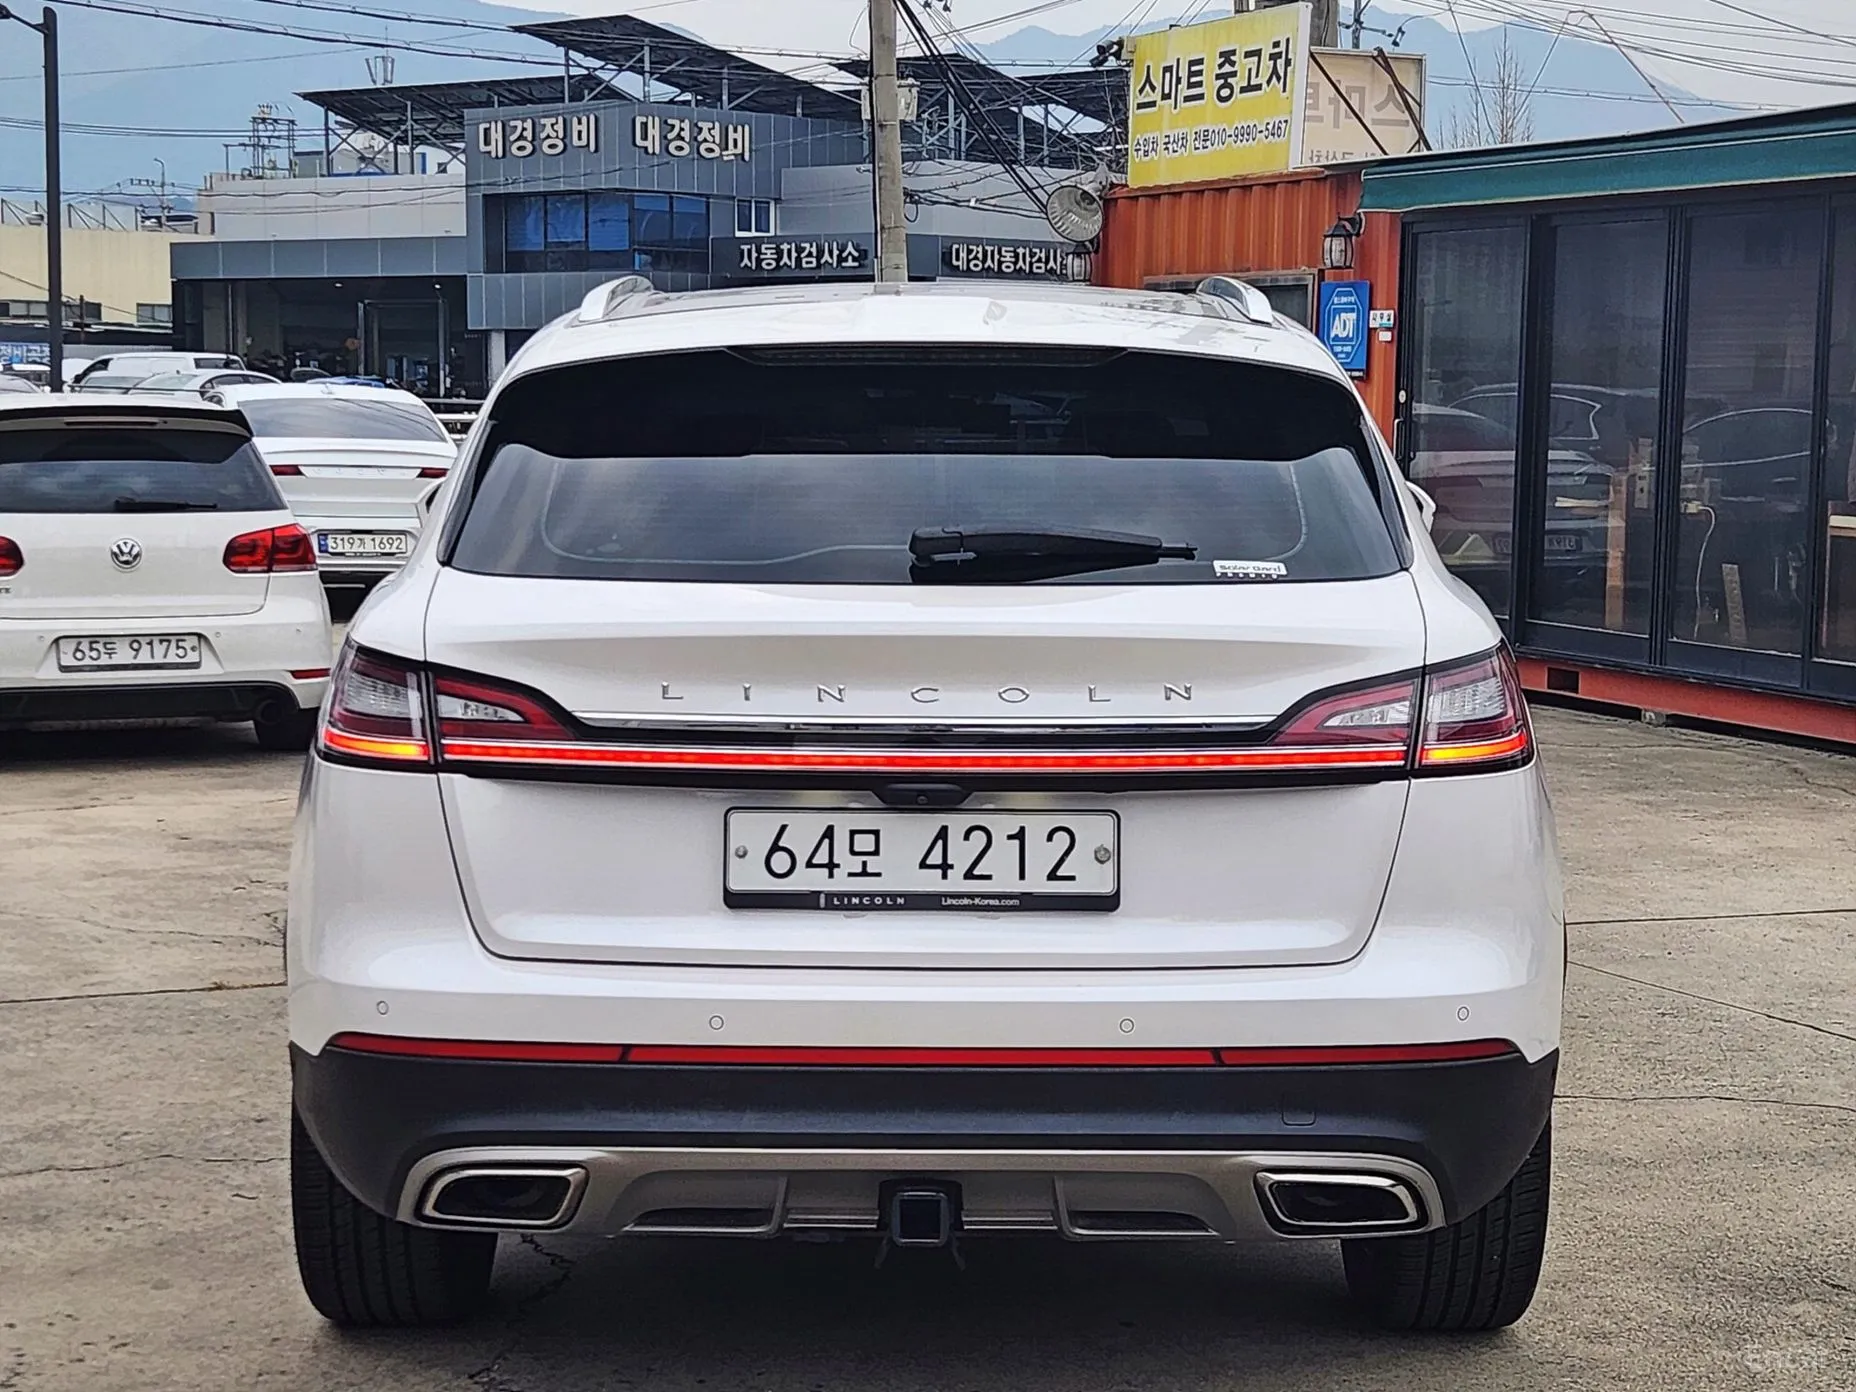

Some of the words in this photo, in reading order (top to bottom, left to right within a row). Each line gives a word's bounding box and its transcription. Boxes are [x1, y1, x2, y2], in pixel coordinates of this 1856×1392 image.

[1136, 57, 1205, 110] 스마트
[1215, 37, 1292, 103] 중고차
[478, 113, 596, 158] 대경정비
[635, 115, 750, 162] 대경정비
[1134, 135, 1159, 159] 수입차
[1163, 130, 1189, 155] 국산차
[739, 240, 861, 270] 자동차검사소
[951, 243, 1067, 275] 대경자동차검사
[1330, 312, 1357, 338] ADT
[371, 537, 404, 550] 1692
[72, 640, 118, 662] 65두
[129, 638, 188, 660] 9175
[661, 682, 1193, 702] LINCOLN
[764, 823, 883, 880] 64모
[918, 824, 1077, 882] 4212
[833, 896, 905, 905] LINCOLN
[941, 896, 1020, 907] Lincoln-Korea.com
